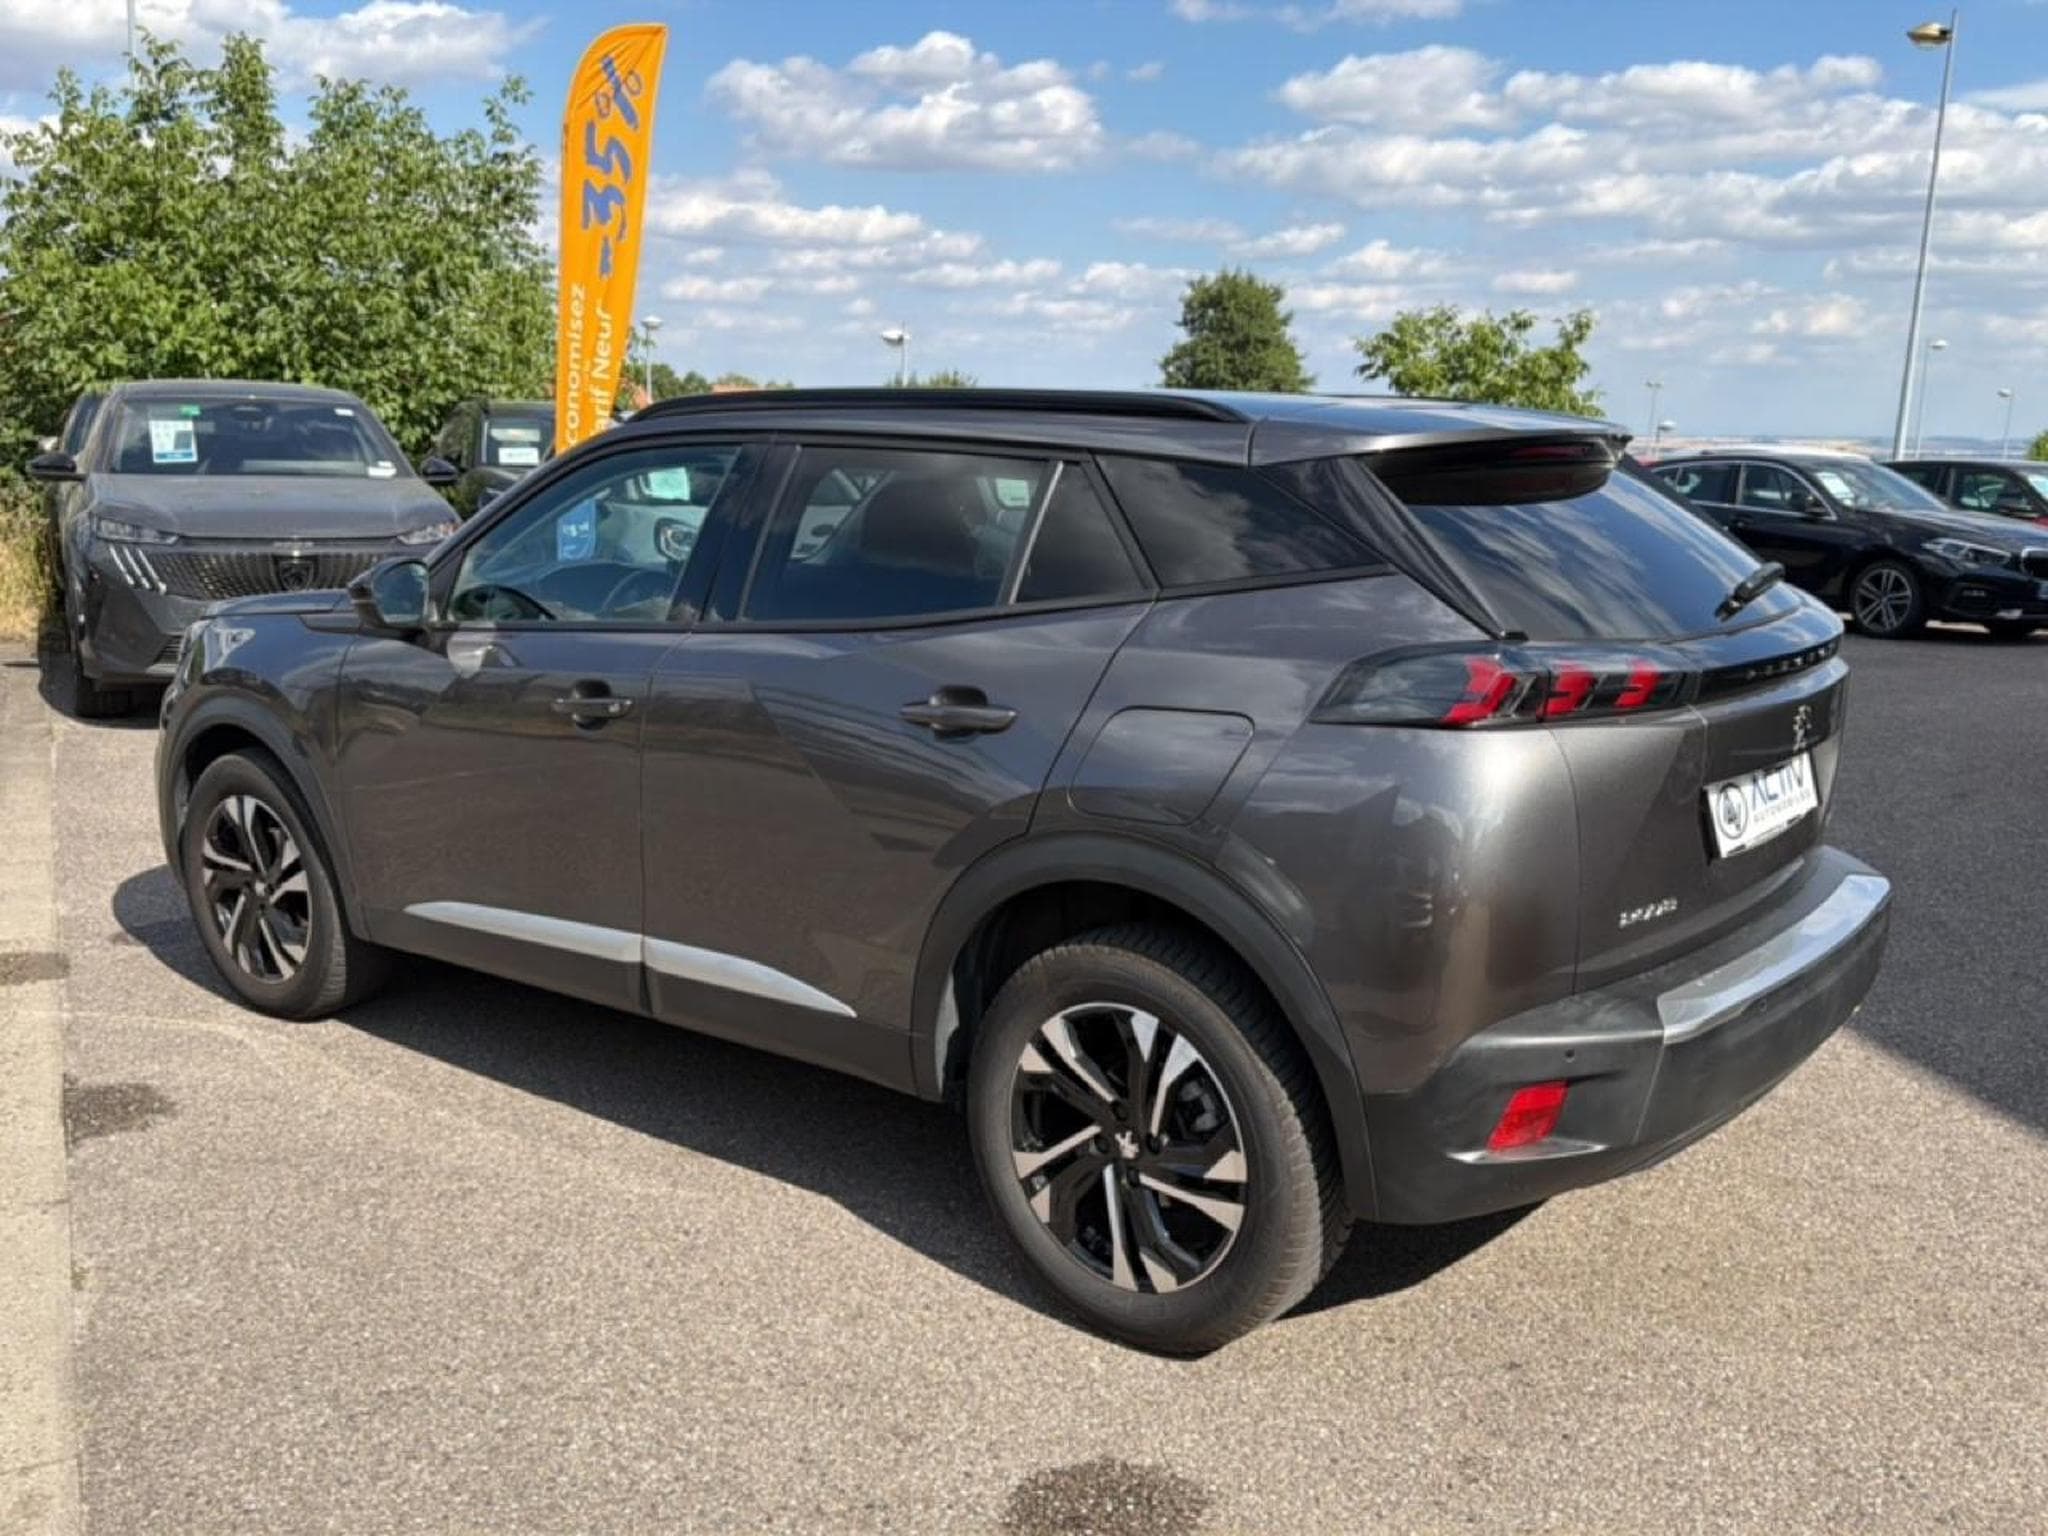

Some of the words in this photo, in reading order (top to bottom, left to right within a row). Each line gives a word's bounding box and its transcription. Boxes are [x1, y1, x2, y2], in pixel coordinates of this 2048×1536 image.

[581, 56, 642, 278] -35%
[564, 283, 586, 447] conomisez
[590, 302, 612, 380] Neuf
[589, 384, 610, 437] arif
